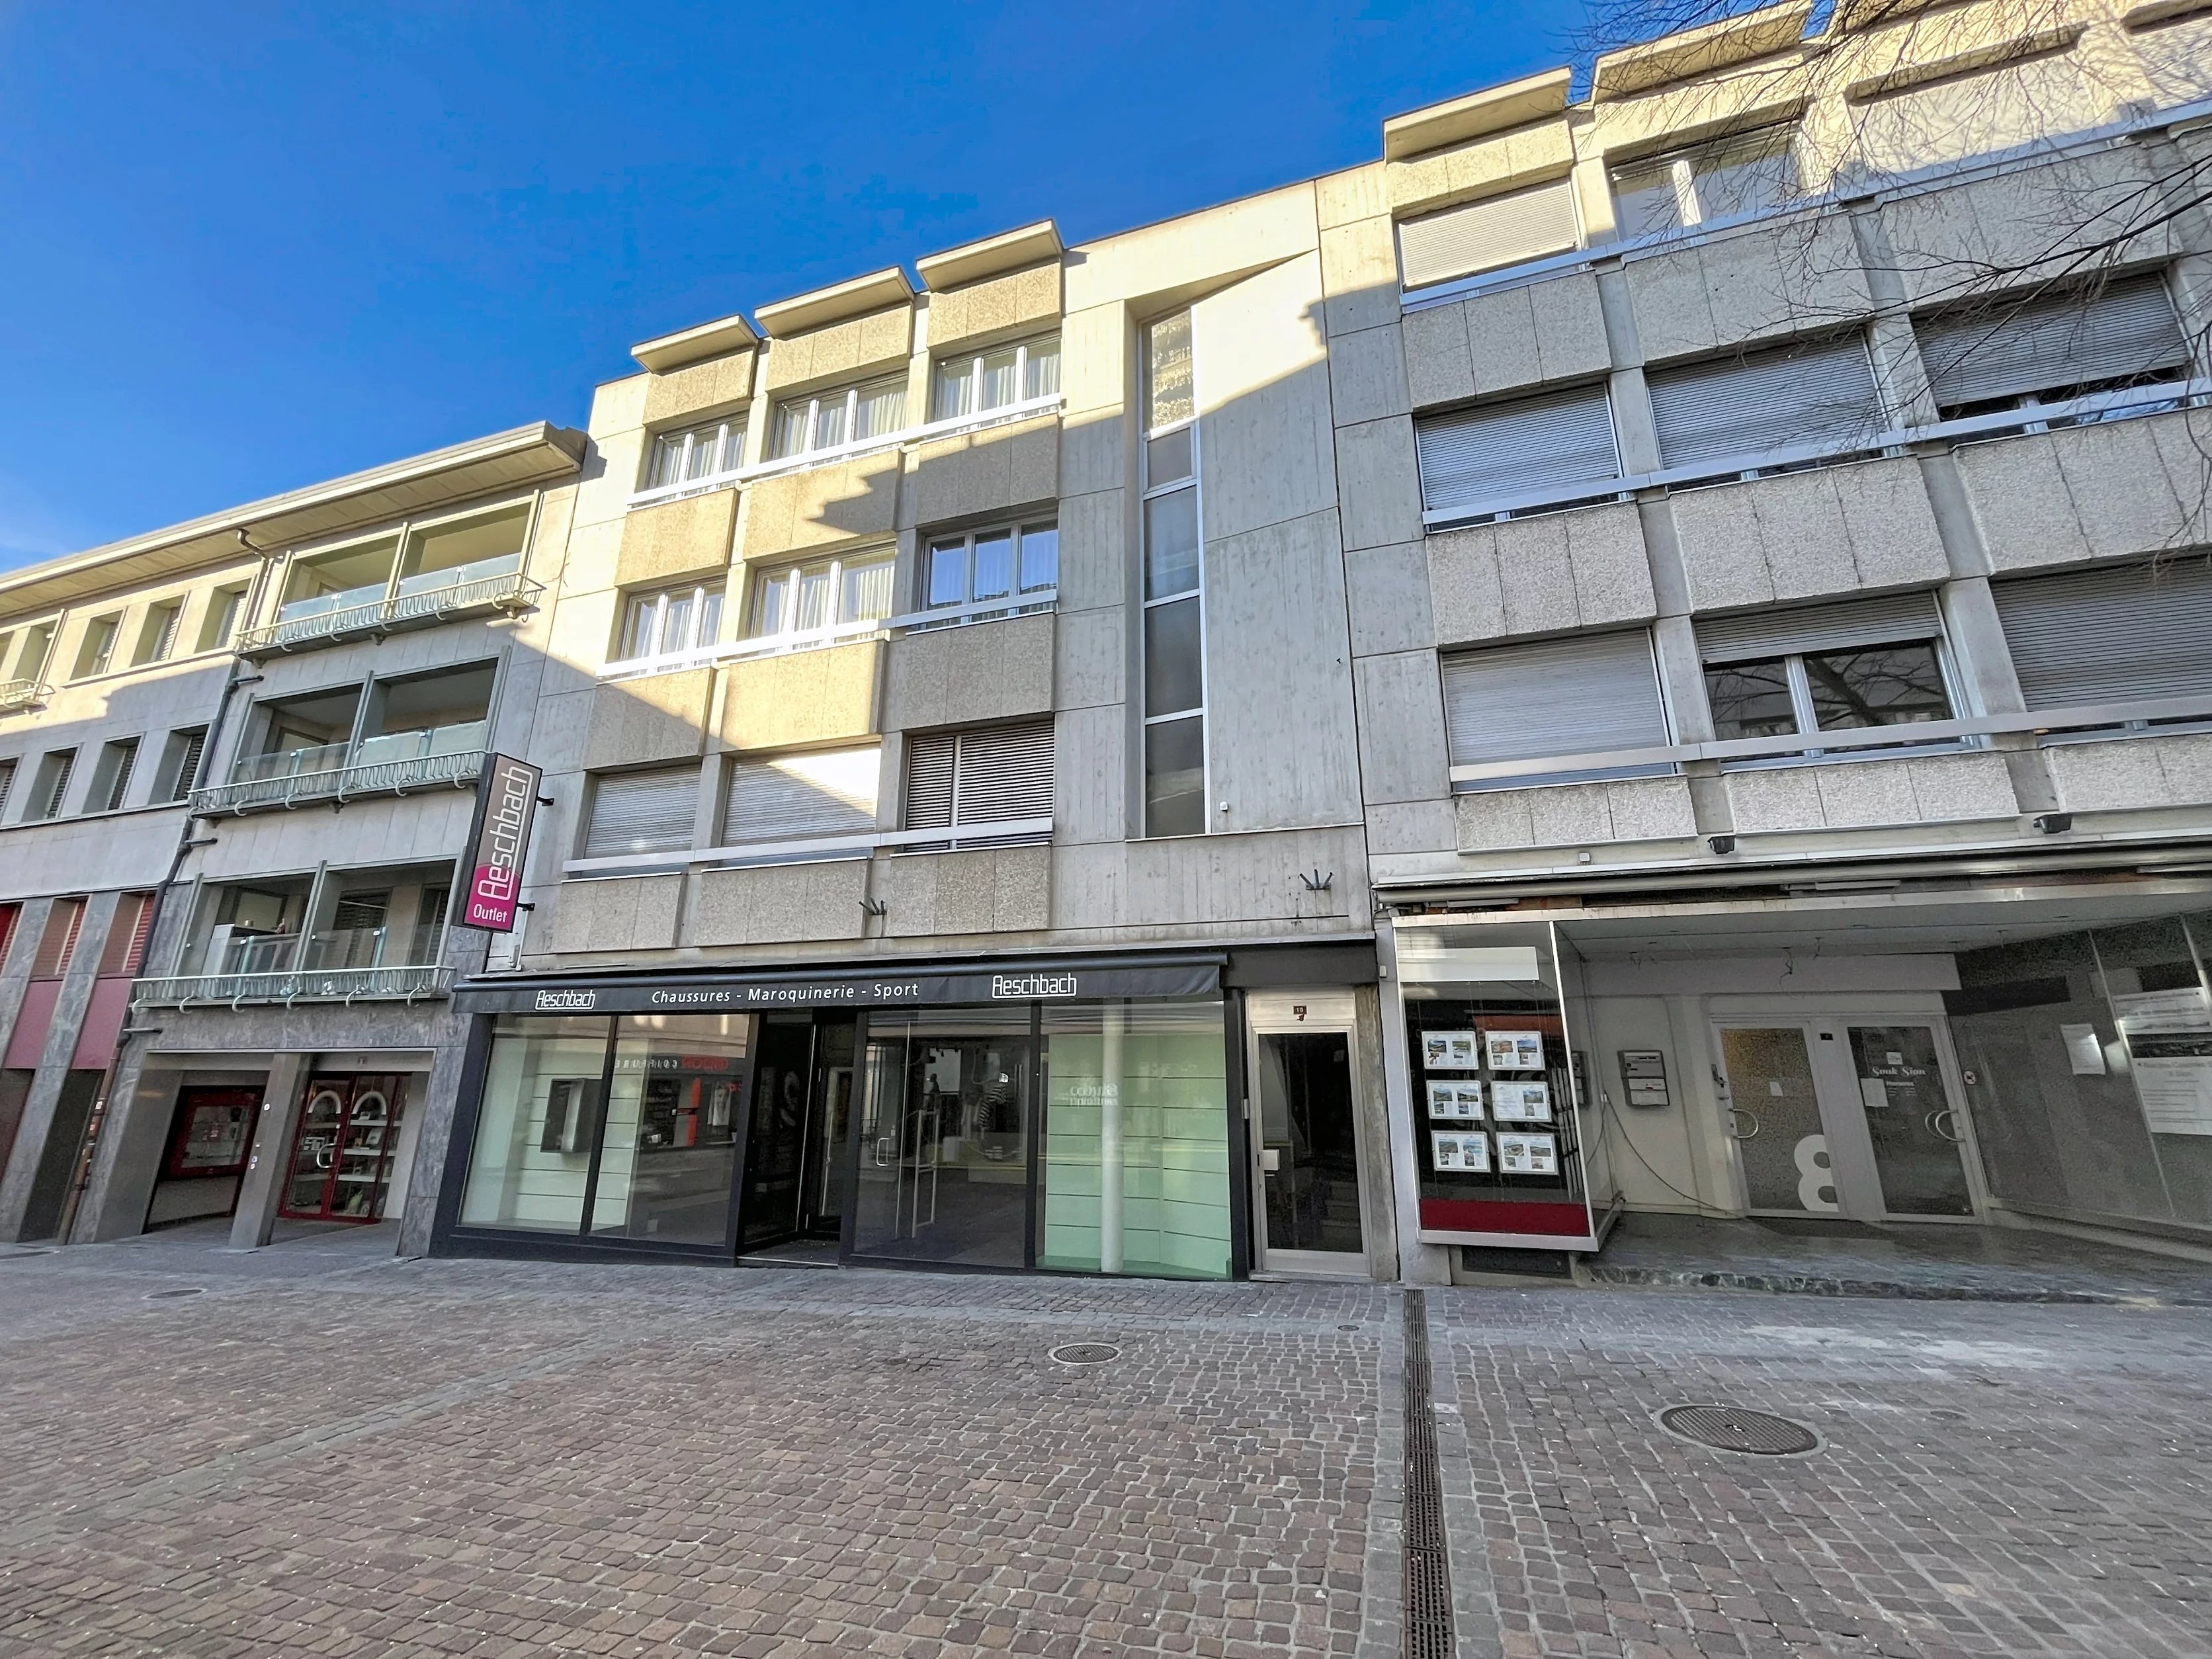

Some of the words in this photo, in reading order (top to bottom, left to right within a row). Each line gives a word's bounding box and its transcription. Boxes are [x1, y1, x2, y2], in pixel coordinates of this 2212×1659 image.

[478, 766, 533, 901] Aeschbach
[473, 904, 508, 923] Outlet
[652, 990, 730, 1003] Chaussures
[747, 985, 854, 1003] Maroquinerie
[873, 983, 919, 1000] Sport
[992, 972, 1077, 1000] Aeschbach
[535, 989, 596, 1011] Aeschbach
